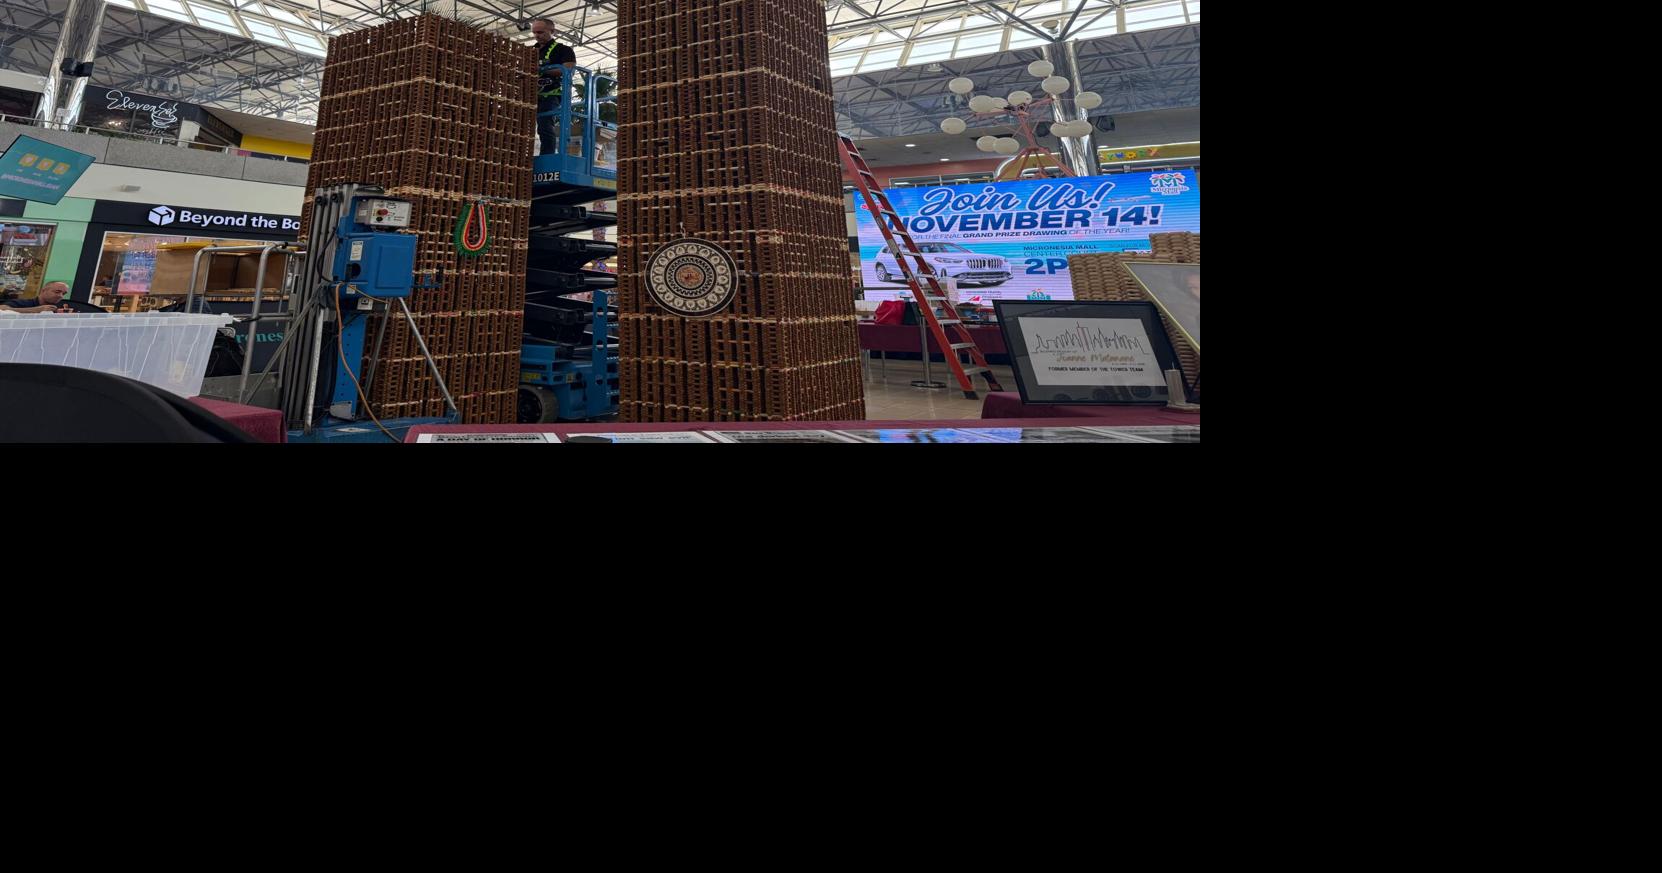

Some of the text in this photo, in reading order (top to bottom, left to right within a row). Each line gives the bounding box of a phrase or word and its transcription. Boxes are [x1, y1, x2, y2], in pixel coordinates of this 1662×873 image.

[919, 186, 1021, 216] Join
[1026, 182, 1115, 211] Us!
[179, 210, 301, 230] Beyond the Bo
[1101, 205, 1162, 227] 14!
[1022, 229, 1068, 237] DRAWING
[1103, 227, 1130, 235] YEAR!
[1023, 250, 1062, 258] CENTER
[1024, 258, 1069, 275] 2P
